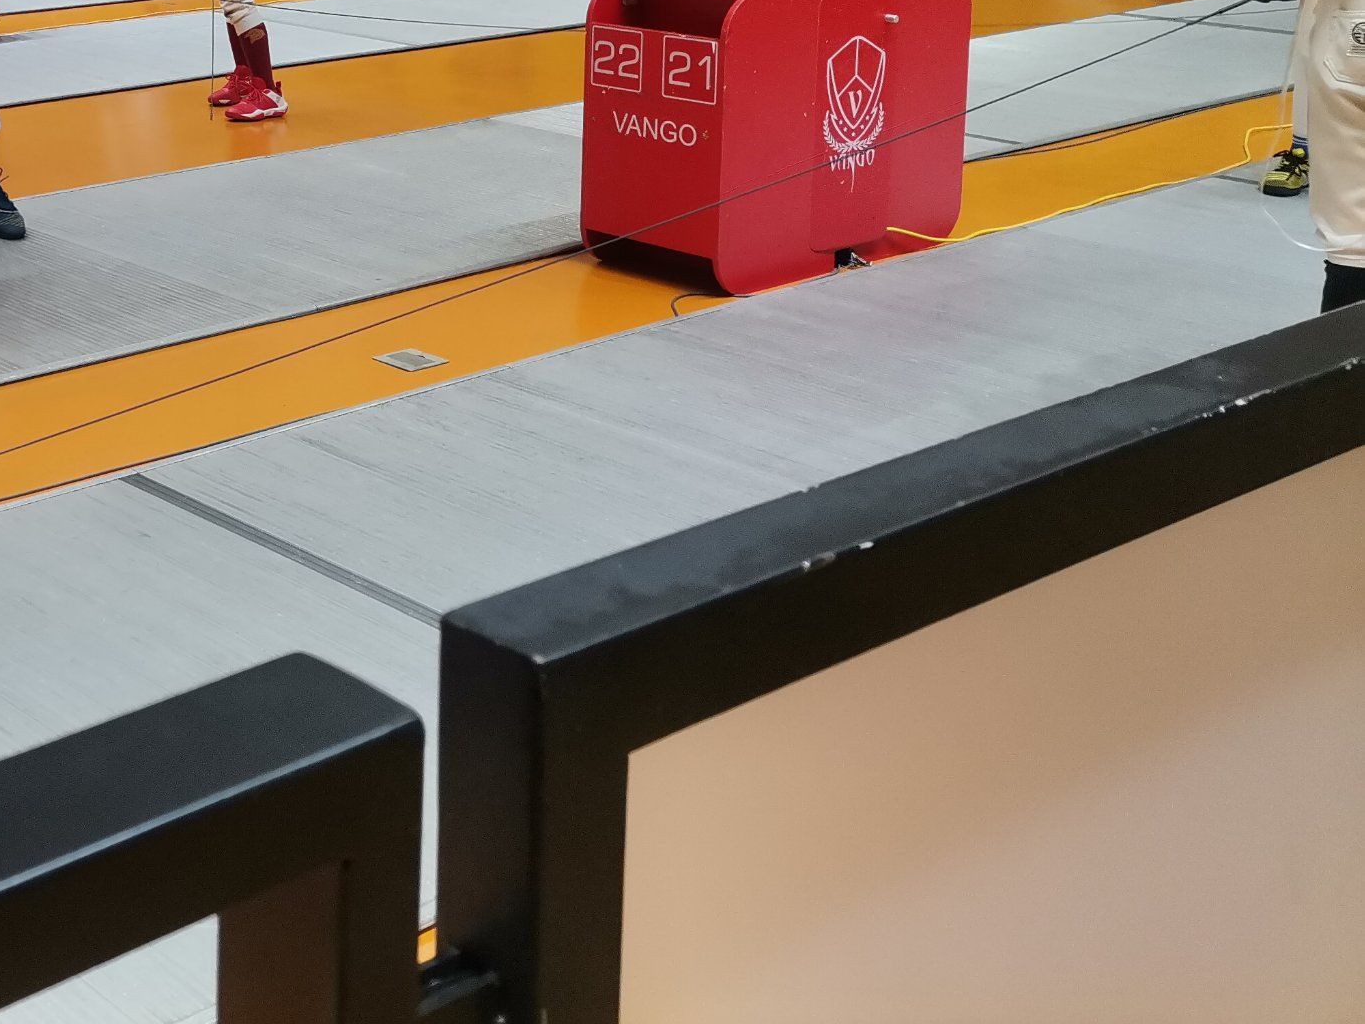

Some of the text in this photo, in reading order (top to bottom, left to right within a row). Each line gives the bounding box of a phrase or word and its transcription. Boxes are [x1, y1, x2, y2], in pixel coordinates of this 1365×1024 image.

[593, 40, 711, 90] 22 21
[612, 110, 697, 147] VANGO
[829, 148, 875, 178] VANGO
